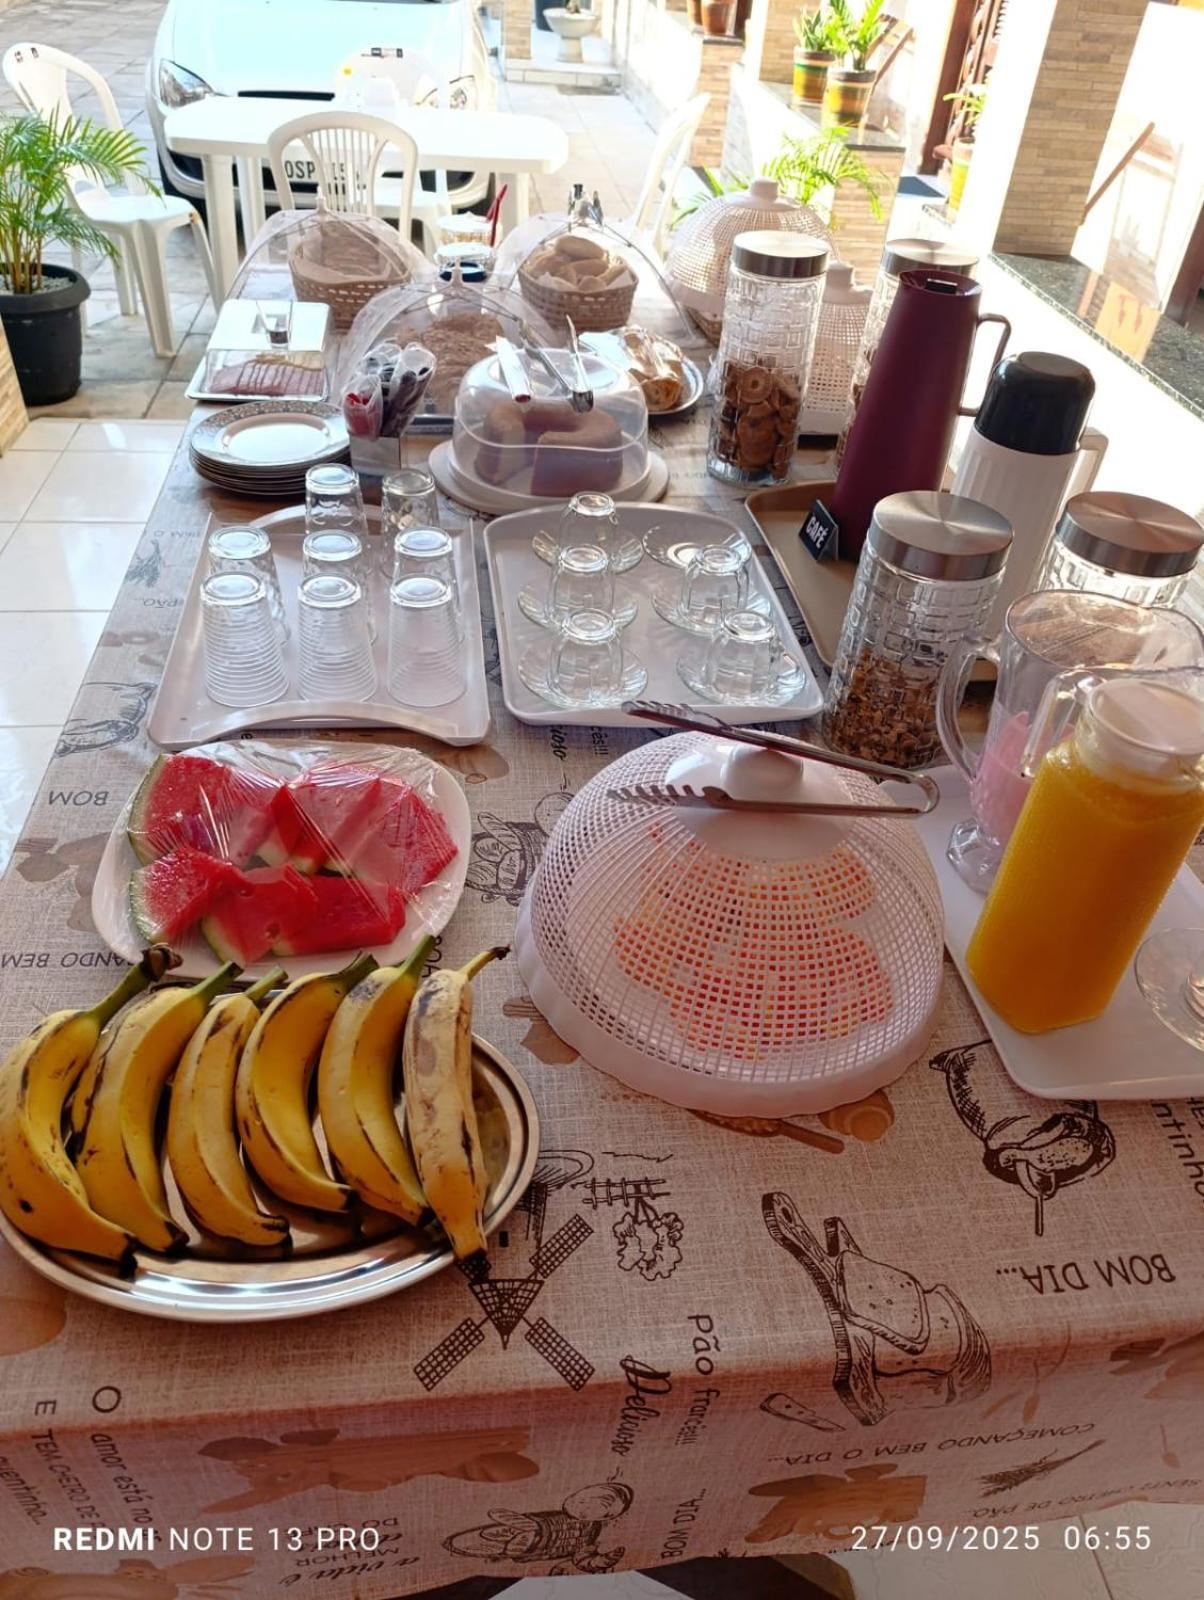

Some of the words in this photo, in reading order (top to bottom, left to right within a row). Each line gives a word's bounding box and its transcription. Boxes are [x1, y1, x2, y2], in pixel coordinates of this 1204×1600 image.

[284, 160, 316, 179] OSP
[805, 515, 830, 549] CAFÉ
[48, 790, 110, 806] BOM
[1, 953, 50, 968] BEM
[60, 952, 135, 968] ANDO
[996, 1261, 1090, 1295] DIA...
[1093, 1254, 1176, 1288] BOM
[687, 1314, 721, 1376] Pão
[34, 1399, 57, 1416] E
[92, 1385, 122, 1413] O
[610, 1354, 673, 1457] Delicioso
[31, 1428, 63, 1461] TEM
[938, 1422, 1096, 1451] COMEÇANDO
[90, 1433, 128, 1471] amor
[843, 1449, 864, 1461] O
[874, 1442, 928, 1457] BEM
[113, 1475, 154, 1504] está
[131, 1508, 154, 1524] no
[362, 1517, 398, 1528] DO
[660, 1527, 693, 1559] BOM
[296, 1547, 399, 1567] MELHOR
[309, 1560, 384, 1580] vida
